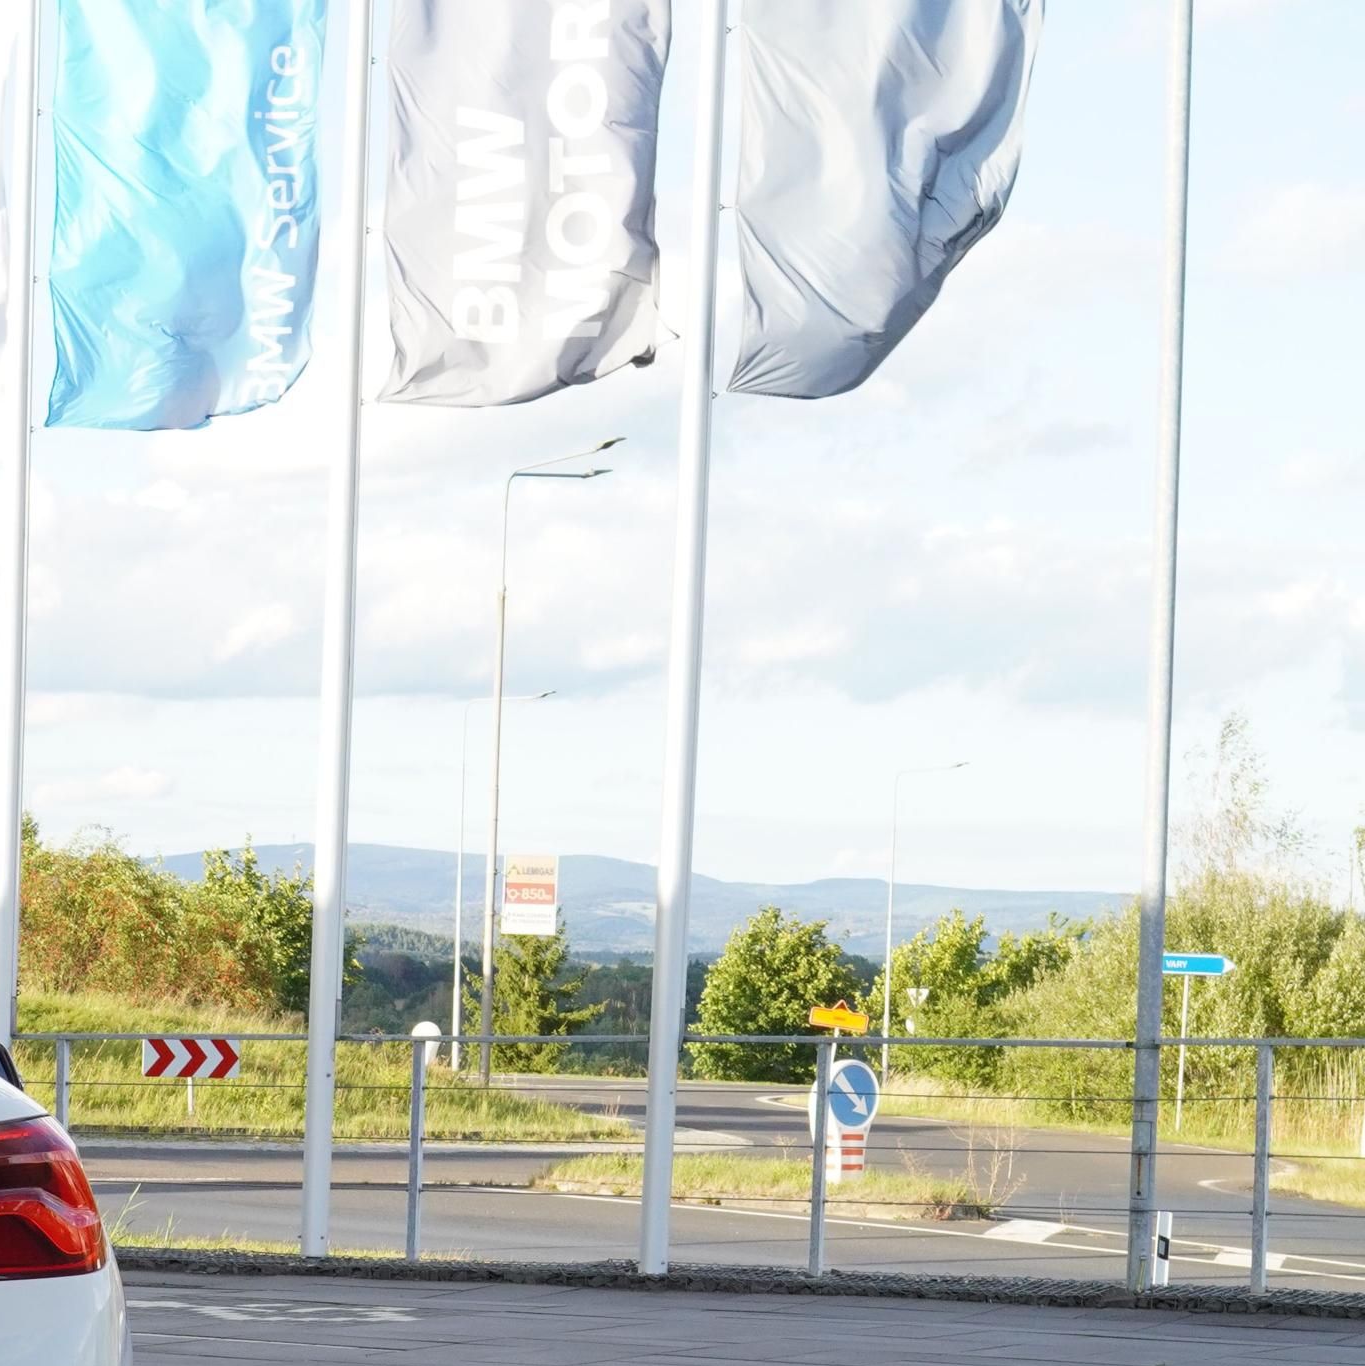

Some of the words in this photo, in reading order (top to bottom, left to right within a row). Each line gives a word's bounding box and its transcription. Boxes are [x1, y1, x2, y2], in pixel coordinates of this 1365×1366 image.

[254, 44, 307, 250] Service
[452, 105, 526, 344] BMW
[1165, 960, 1188, 968] VARY
